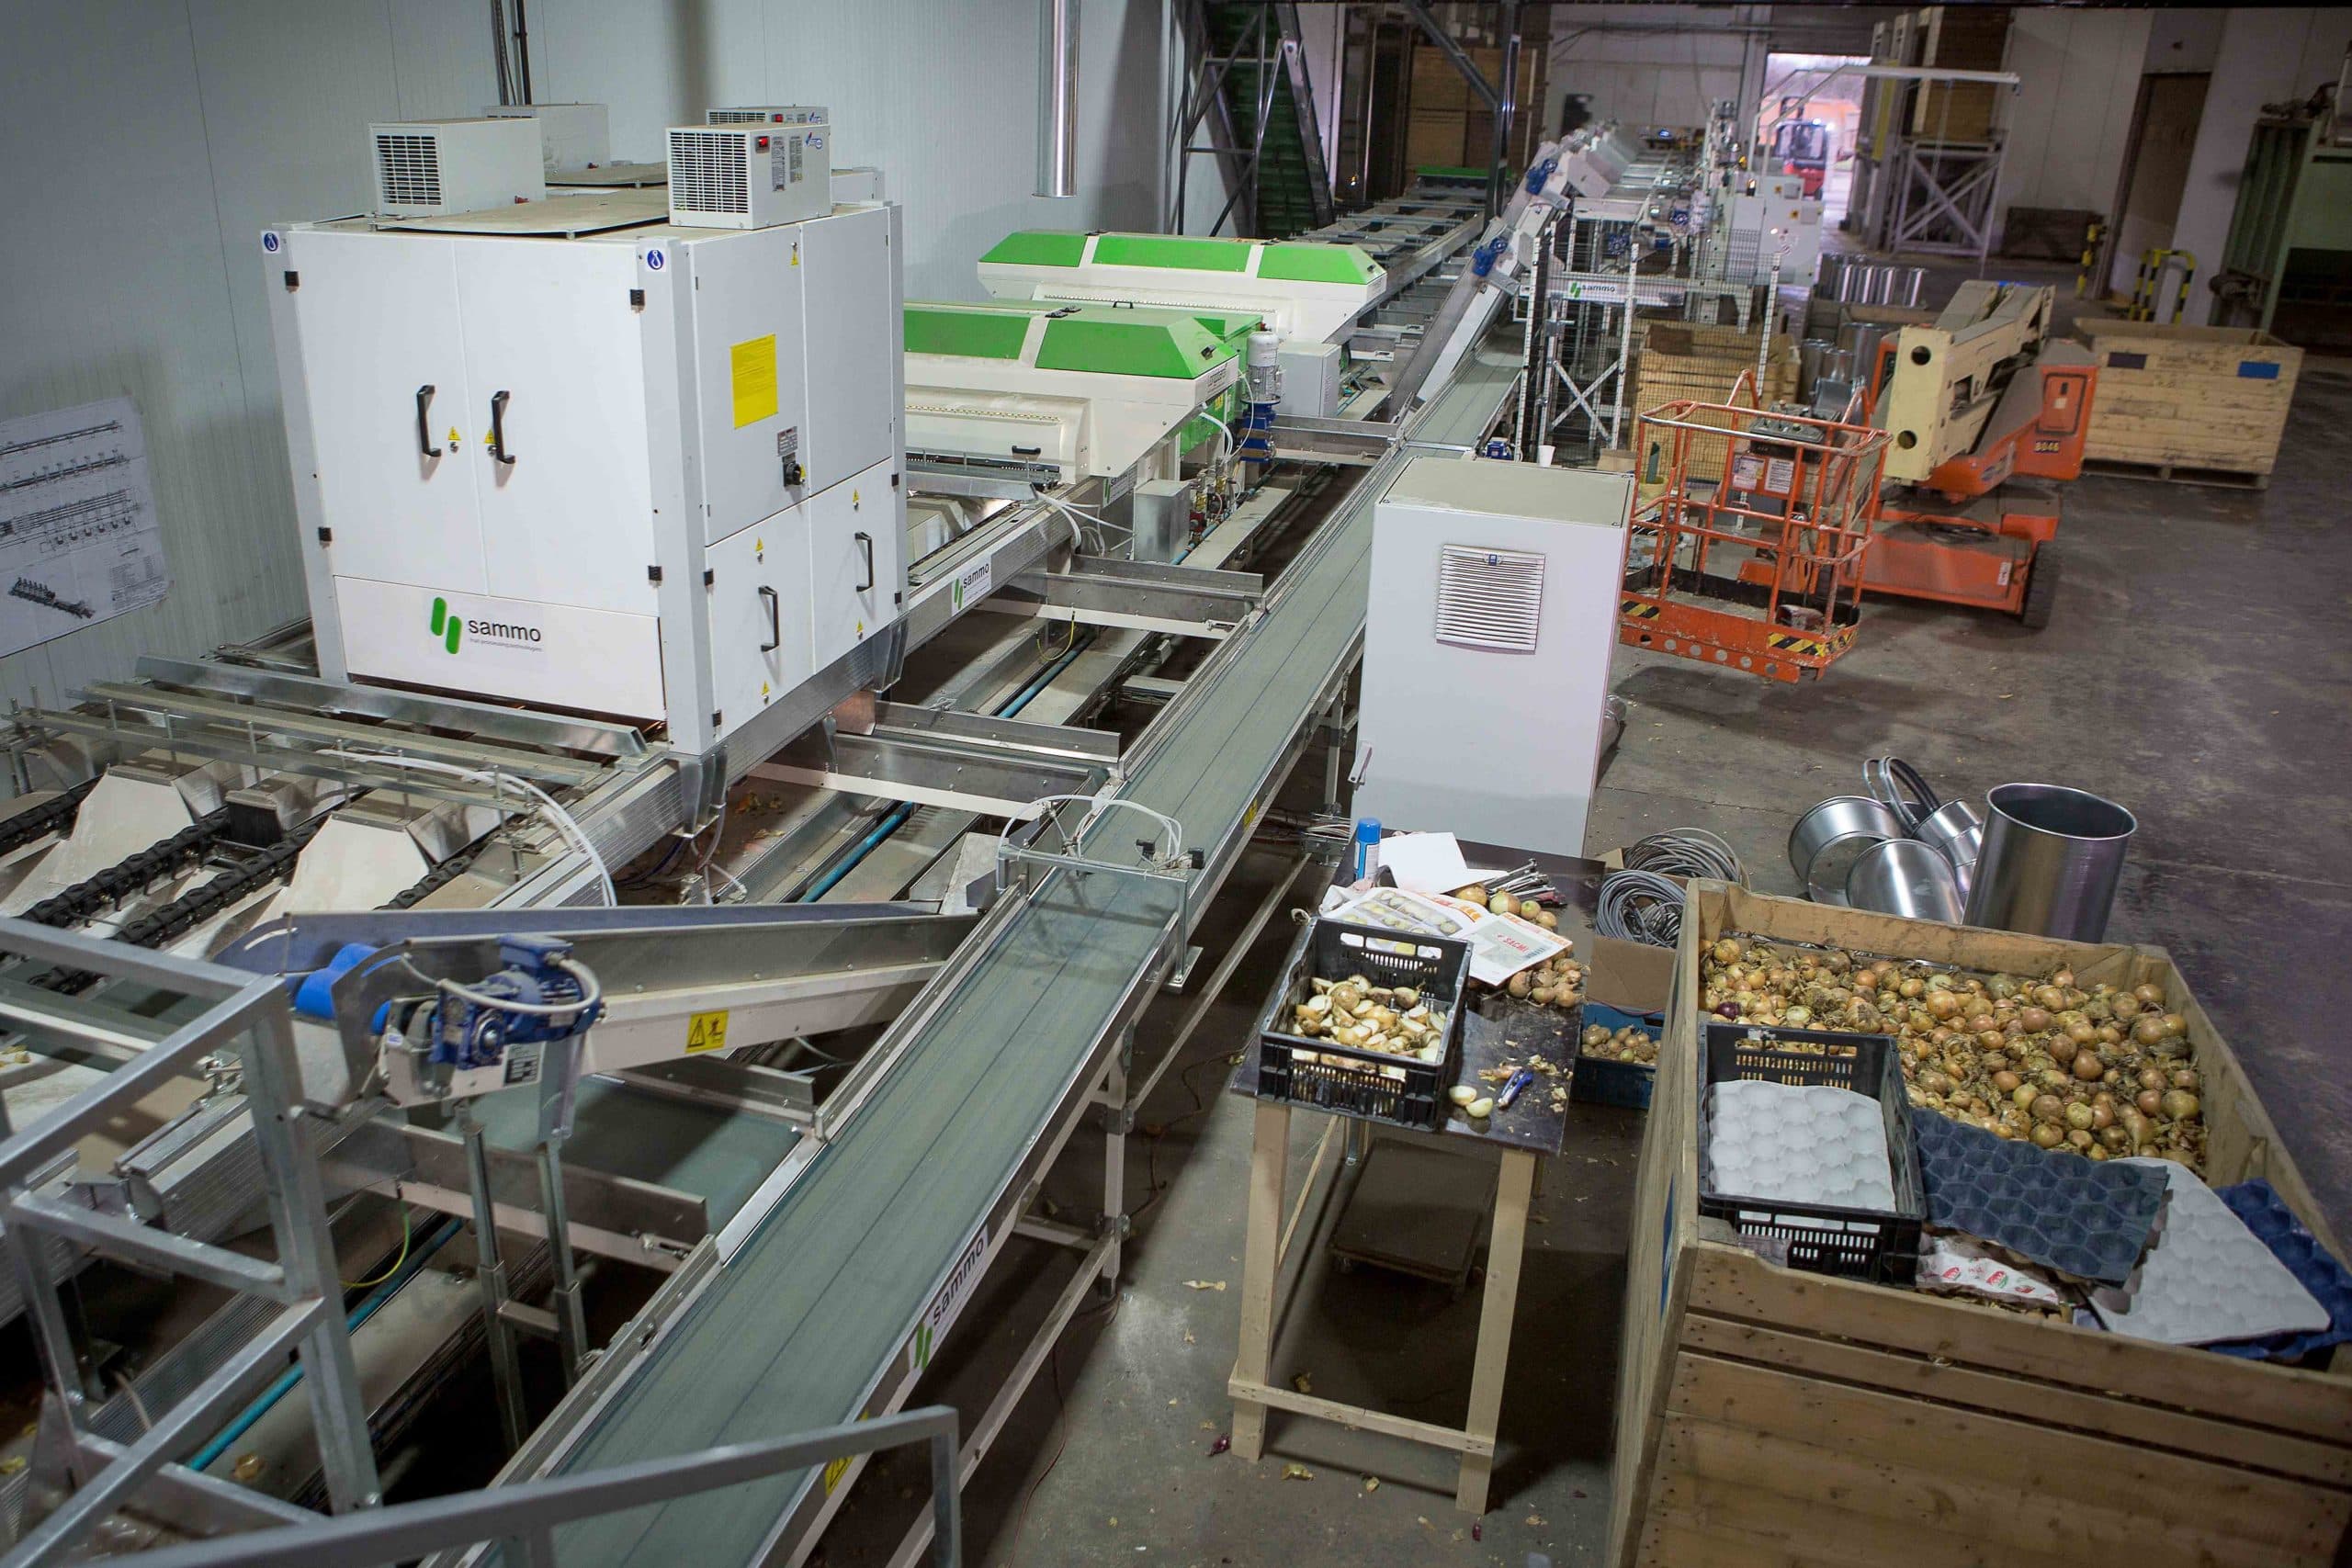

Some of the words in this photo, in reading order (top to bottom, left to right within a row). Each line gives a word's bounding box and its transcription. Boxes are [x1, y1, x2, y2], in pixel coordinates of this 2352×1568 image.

[1582, 285, 1616, 293] sammo
[963, 563, 989, 588] sammo
[469, 620, 541, 642] sammo
[933, 1237, 984, 1325] sammo
